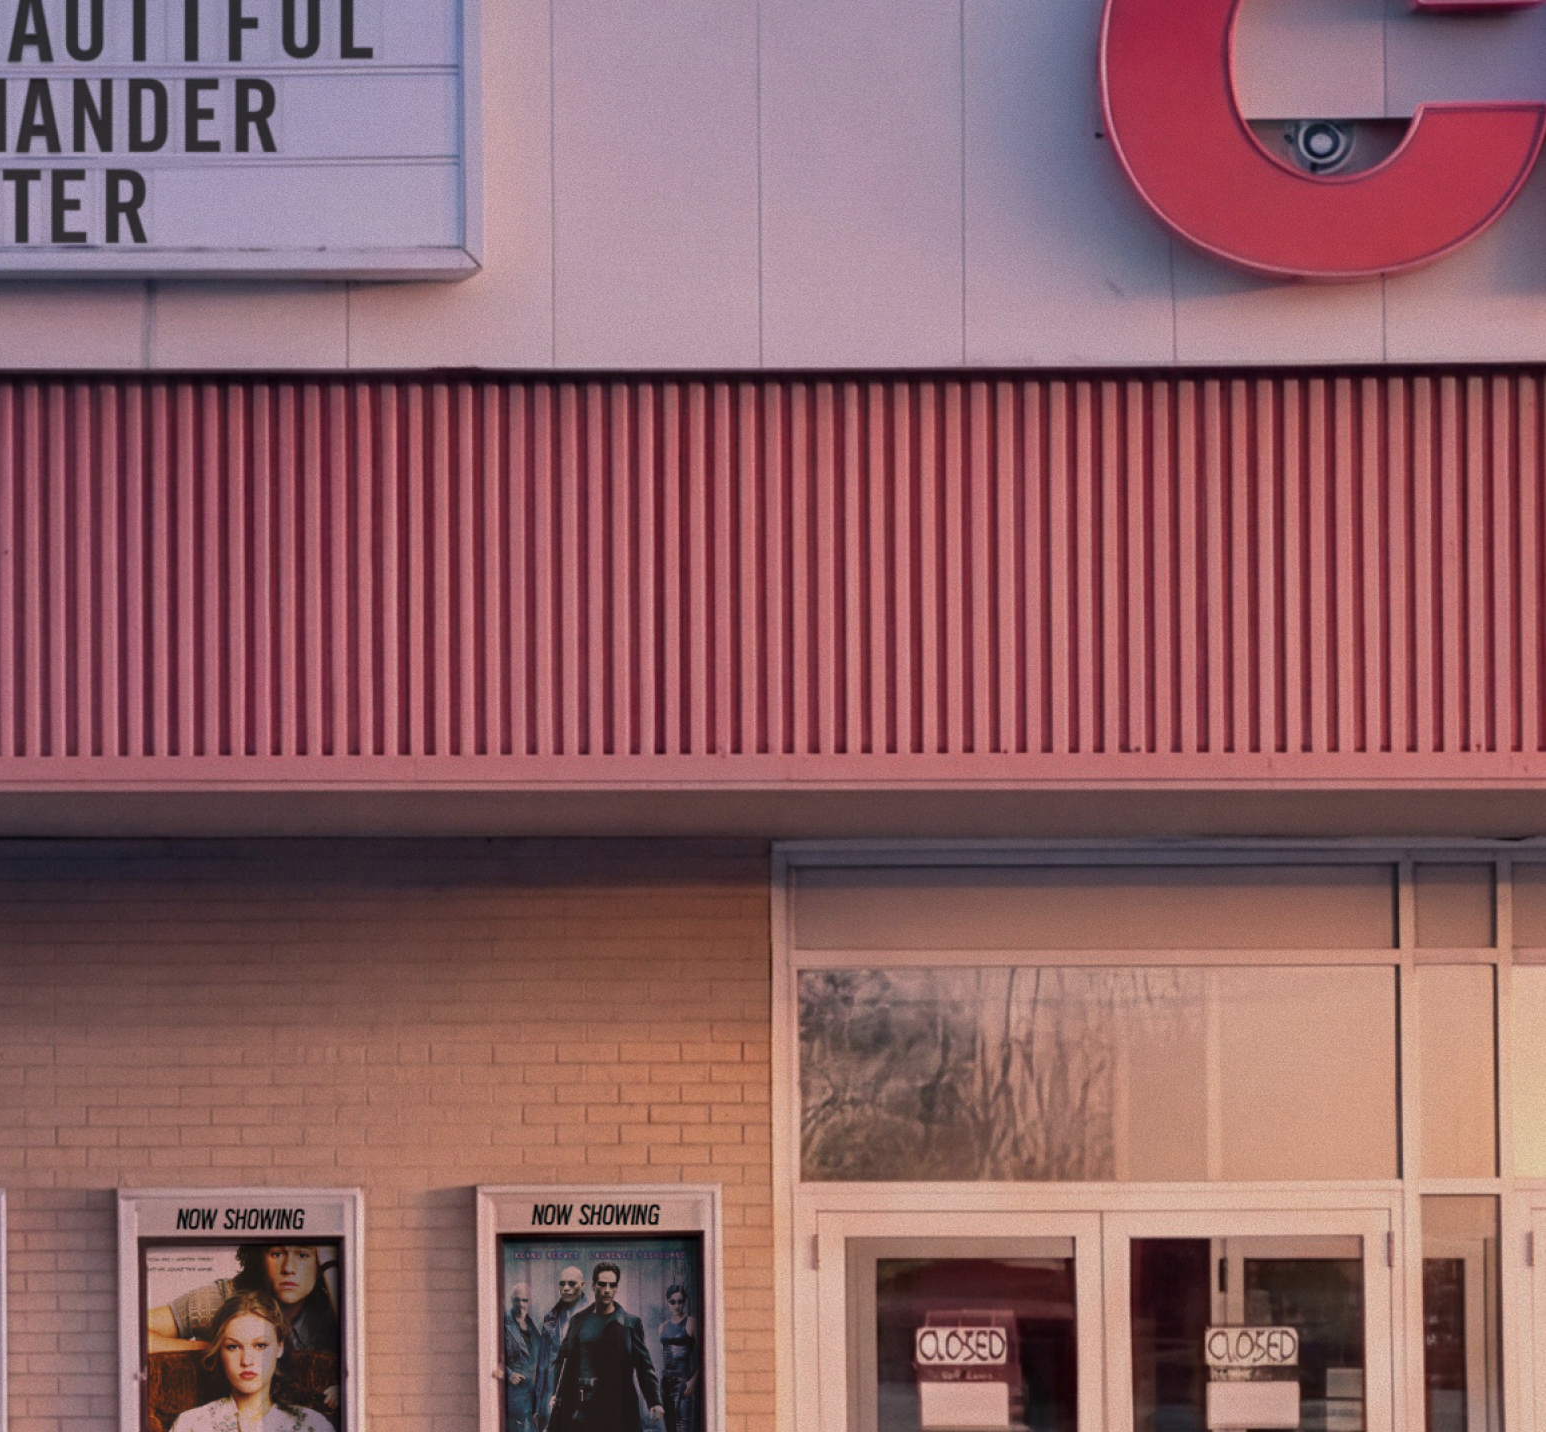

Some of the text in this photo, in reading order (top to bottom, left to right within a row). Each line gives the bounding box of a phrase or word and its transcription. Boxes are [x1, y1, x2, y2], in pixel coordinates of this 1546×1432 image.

[176, 1208, 306, 1230] NOW SHOWING
[531, 1204, 661, 1225] NOW SHOWING
[919, 1329, 1007, 1361] CLOSED
[1207, 1330, 1296, 1362] CLOSED
